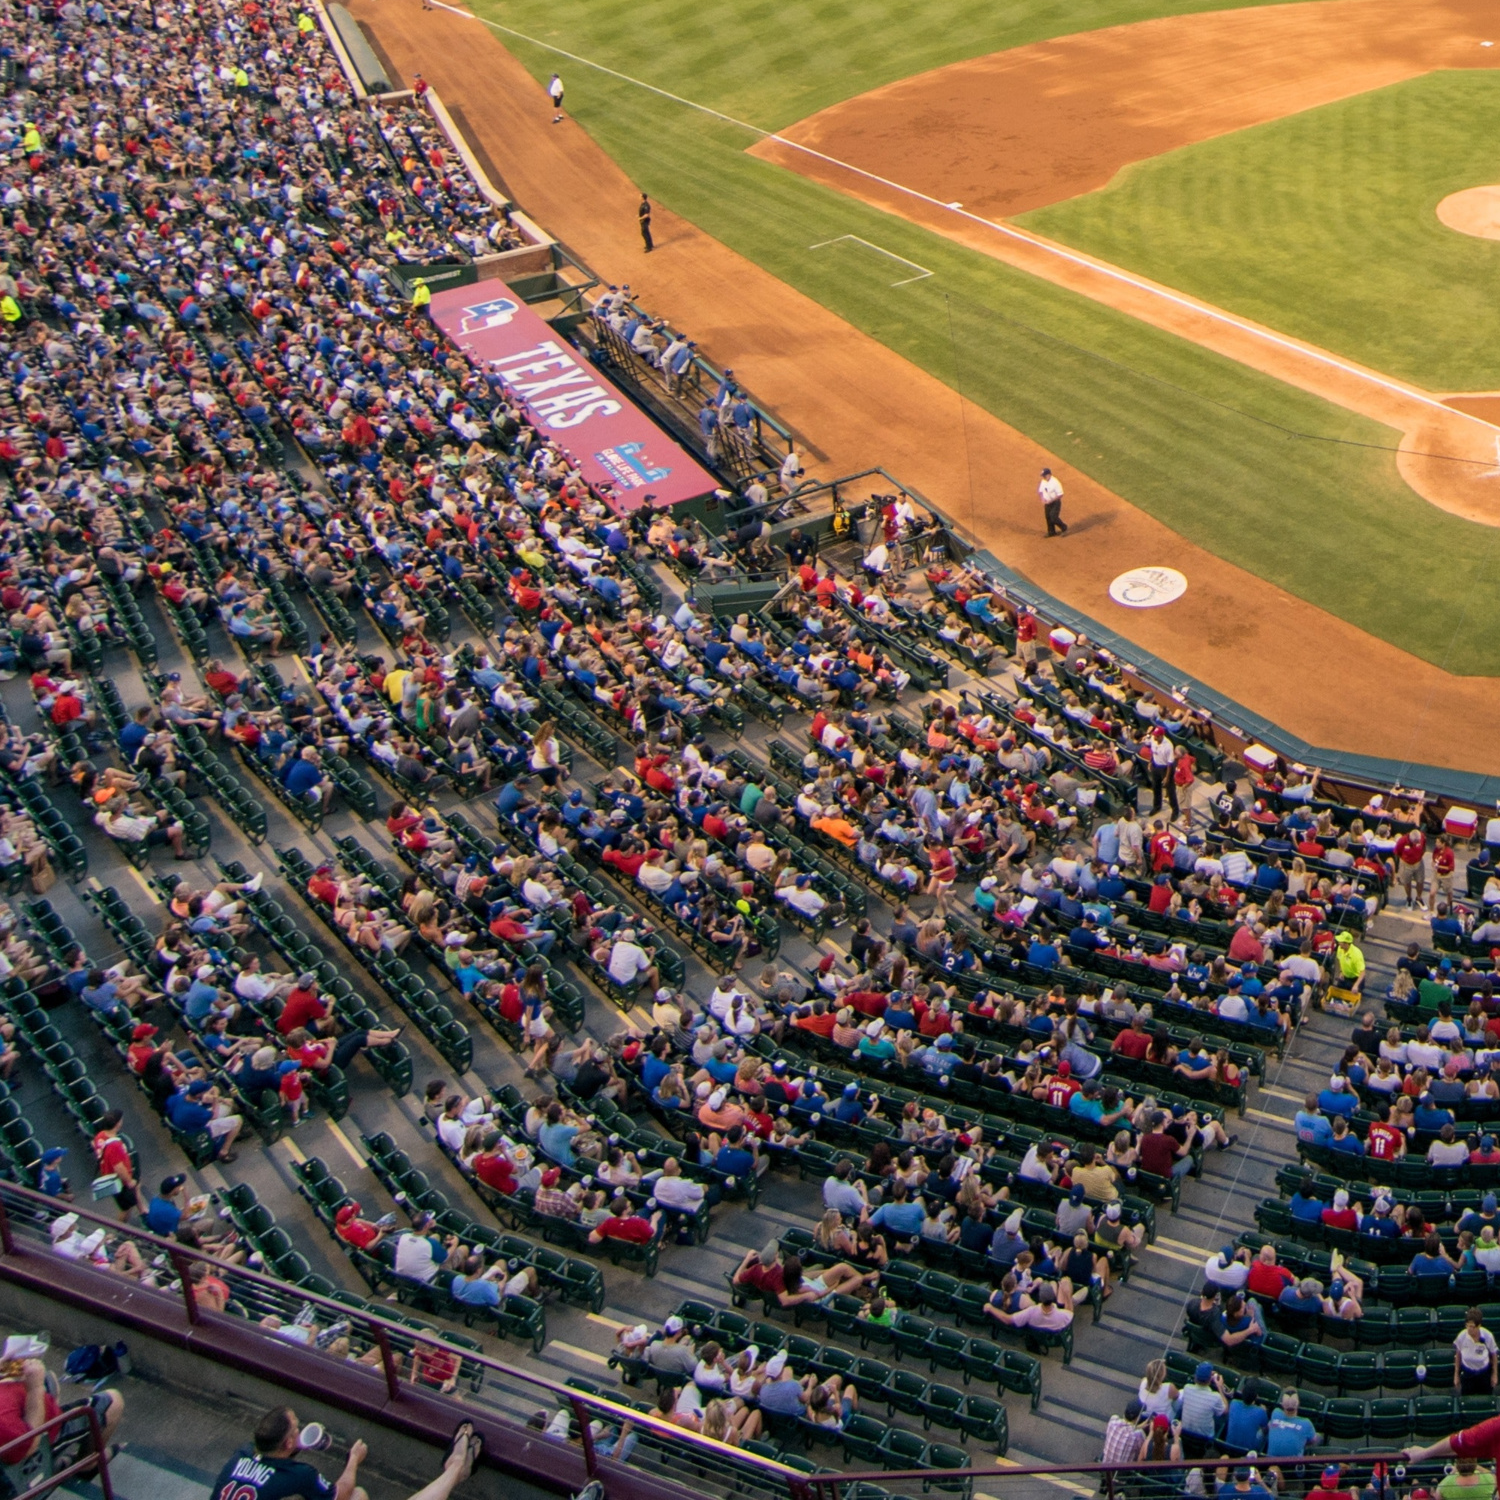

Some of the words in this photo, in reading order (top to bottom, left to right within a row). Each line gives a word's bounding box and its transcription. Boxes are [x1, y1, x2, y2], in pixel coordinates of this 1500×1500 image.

[487, 339, 623, 429] TEXAS
[1053, 1091, 1062, 1106] 11
[1375, 1138, 1385, 1154] 11
[231, 1457, 276, 1486] YOUNG
